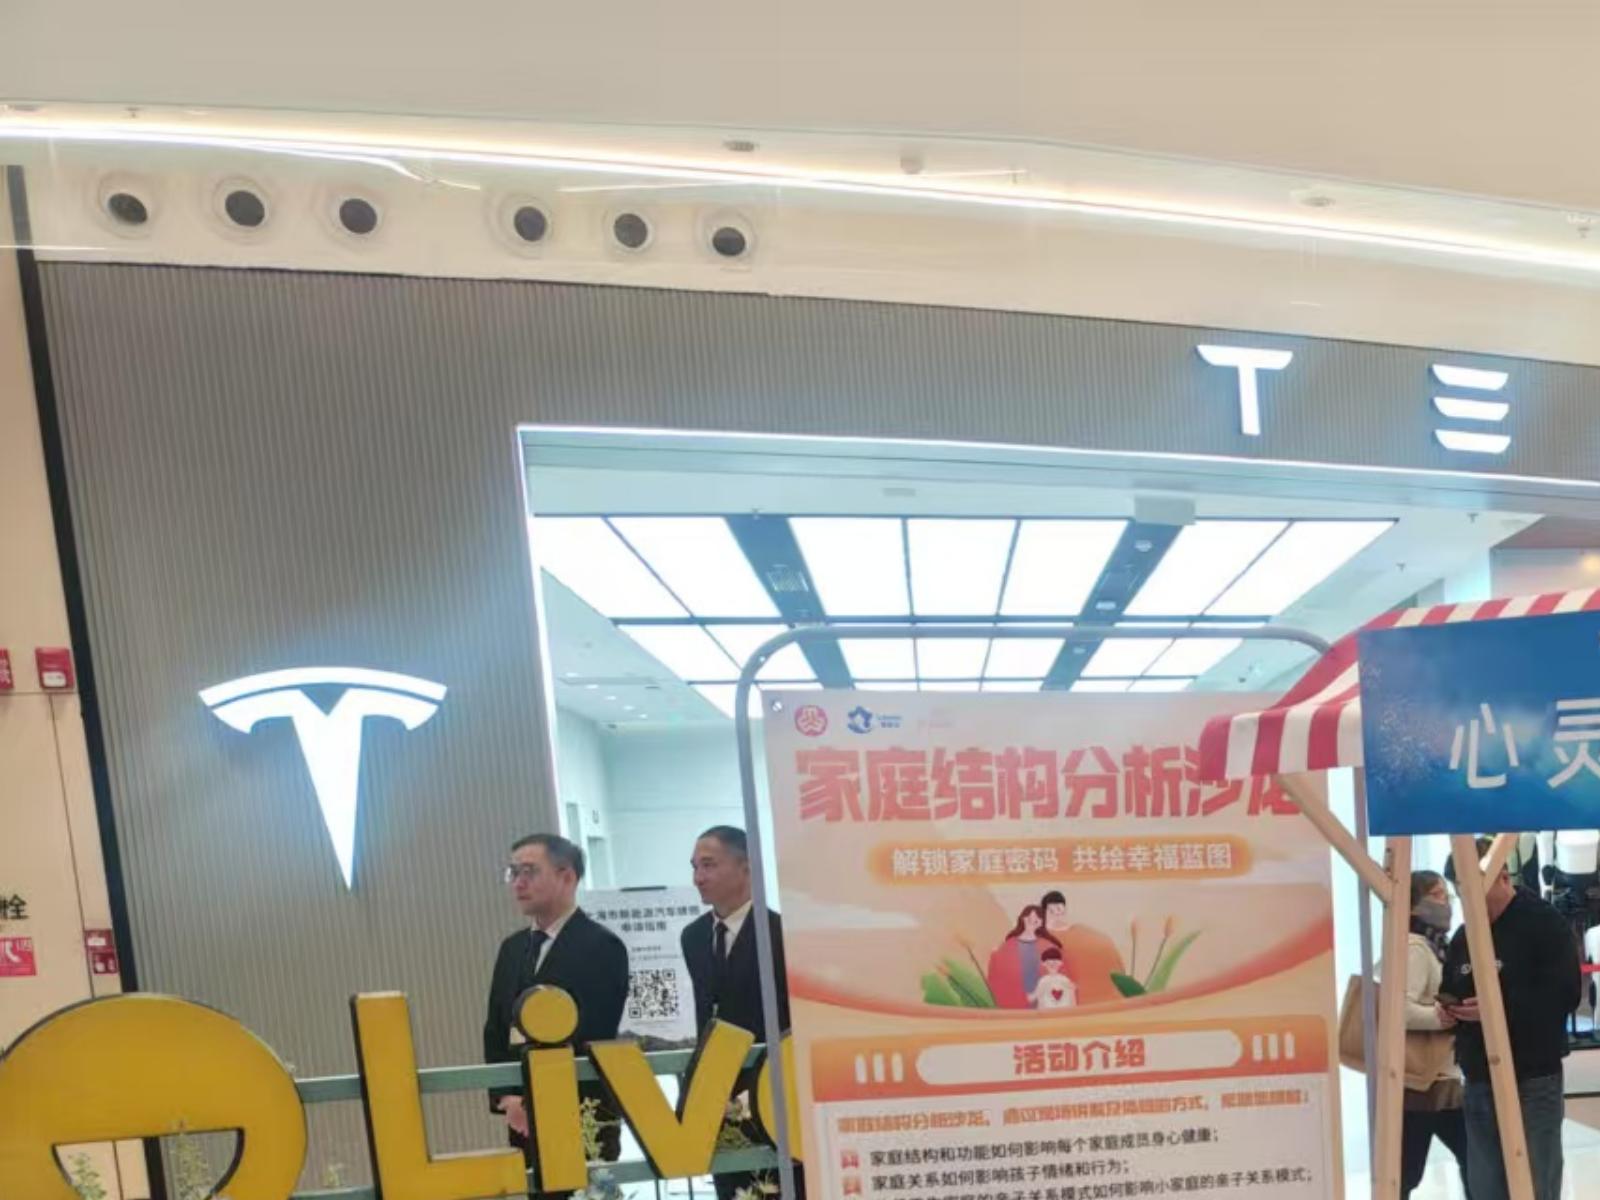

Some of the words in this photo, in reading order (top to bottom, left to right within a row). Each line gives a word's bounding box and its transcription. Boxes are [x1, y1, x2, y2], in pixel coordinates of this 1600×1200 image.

[893, 847, 1058, 876] 解锁家庭密码
[1072, 842, 1232, 872] 共绘幸福蓝图
[1013, 1038, 1145, 1075] 活动介绍
